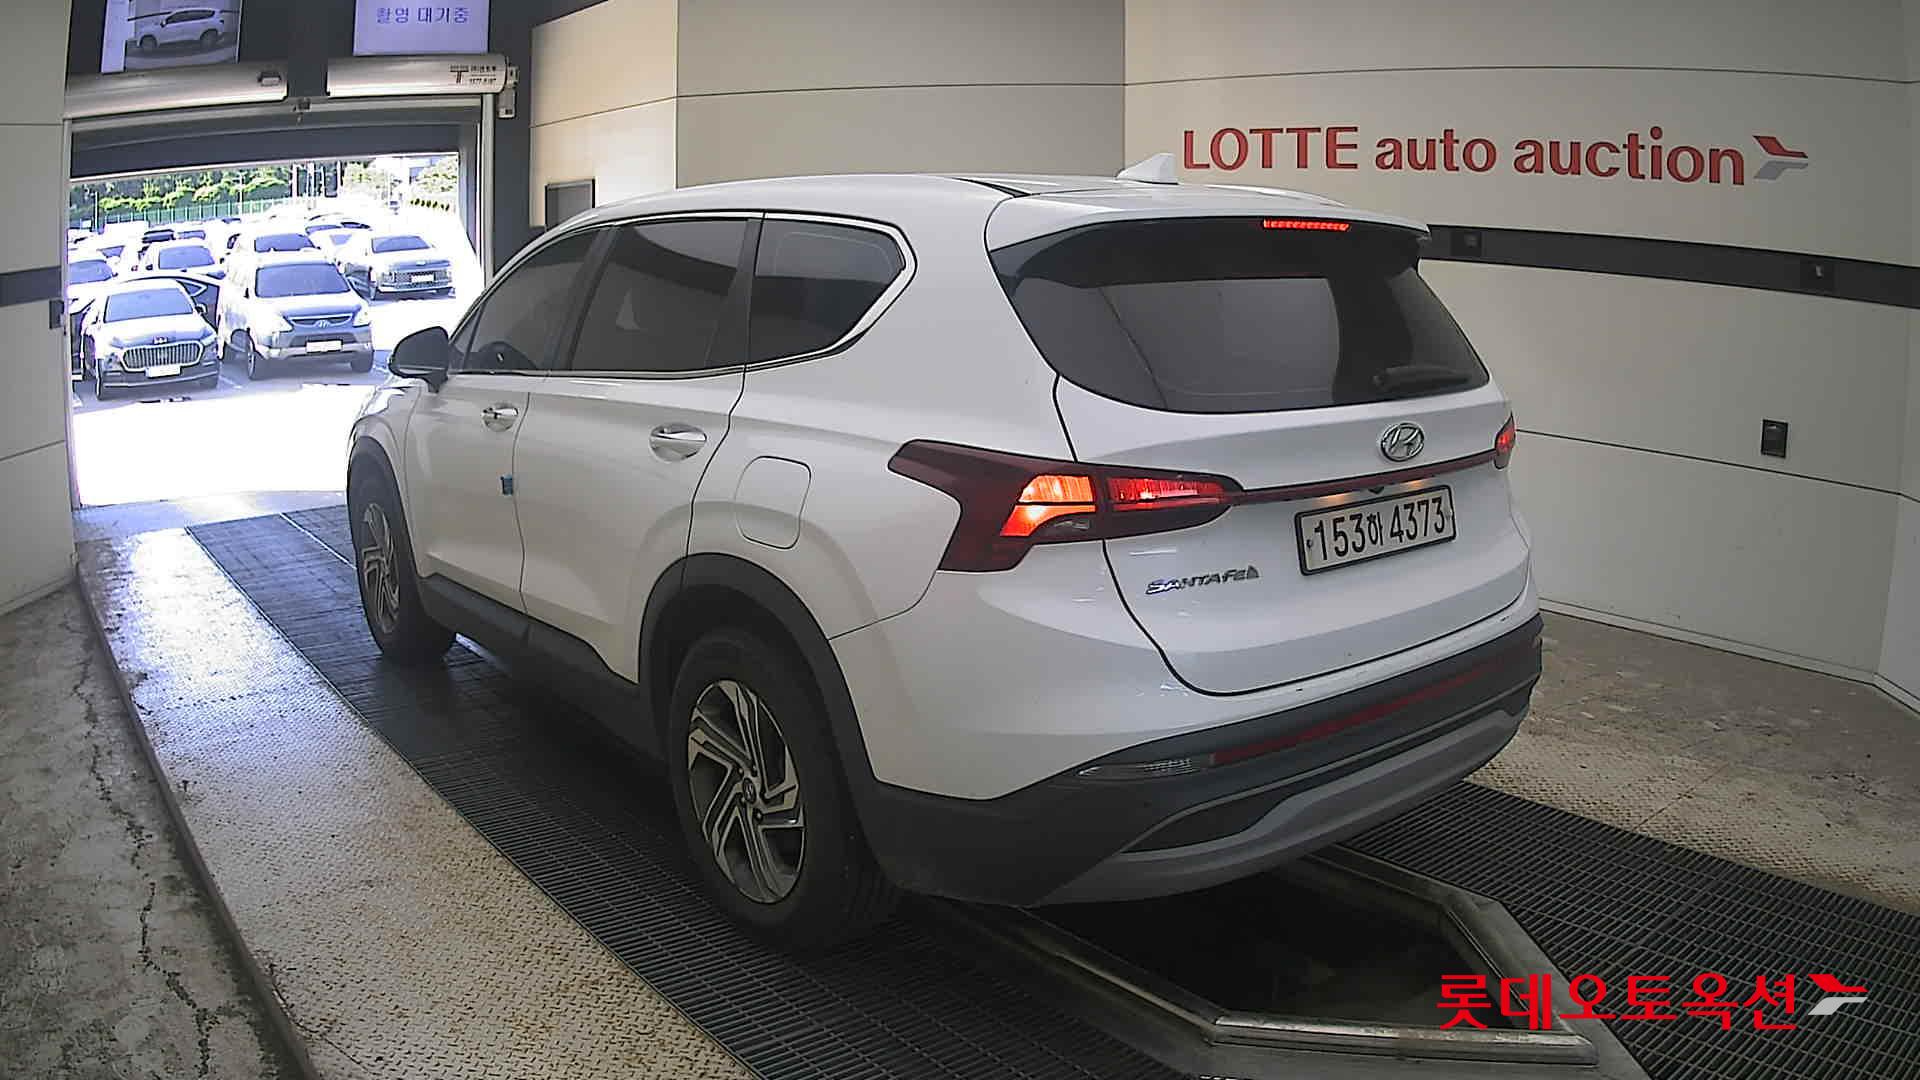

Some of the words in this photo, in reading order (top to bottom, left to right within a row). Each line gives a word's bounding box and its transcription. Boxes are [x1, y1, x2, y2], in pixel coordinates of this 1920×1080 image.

[418, 7, 468, 24] 대기중
[1183, 127, 1359, 171] LOTTE
[1375, 128, 1498, 173] auto
[1513, 127, 1746, 185] auction
[1314, 511, 1384, 561] 153하
[1390, 496, 1446, 543] 4373
